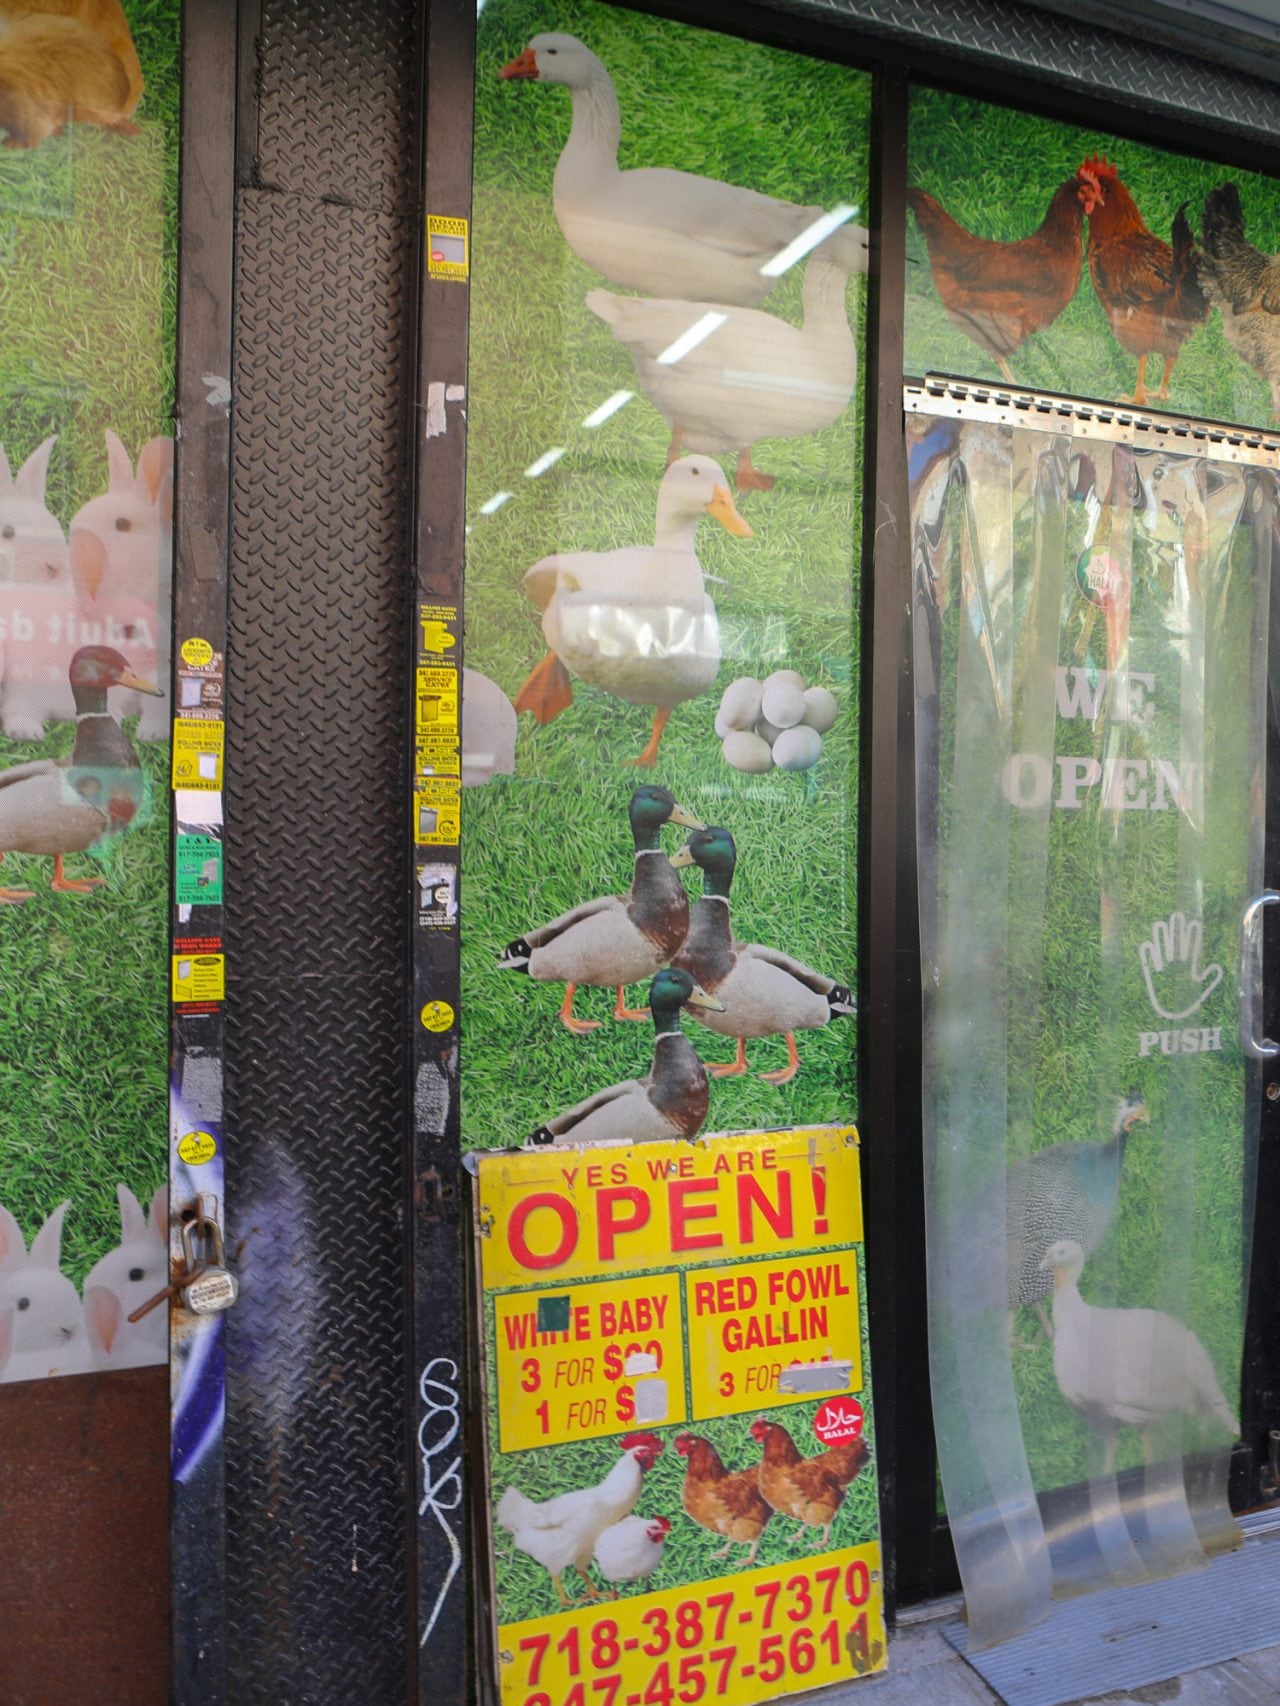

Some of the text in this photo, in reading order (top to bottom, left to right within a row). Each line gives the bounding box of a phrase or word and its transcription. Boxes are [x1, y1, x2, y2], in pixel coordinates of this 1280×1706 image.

[1055, 666, 1156, 723] WE
[1001, 752, 1203, 811] OPEN
[1138, 1026, 1222, 1057] PUSH
[561, 1148, 779, 1189] YES WE ARE
[507, 1165, 829, 1271] OPEN!
[695, 1263, 850, 1317] RED FOWL
[599, 1294, 669, 1338] BABY
[722, 1305, 828, 1353] GALLIN
[521, 1358, 541, 1393] 3
[554, 1357, 595, 1389] FOR
[720, 1363, 782, 1397] 3 FOR
[536, 1400, 550, 1434] 1
[567, 1398, 607, 1430] FOR
[816, 1406, 861, 1432] حلال
[823, 1427, 857, 1440] HALAL
[519, 1560, 870, 1686] 718-387-7370
